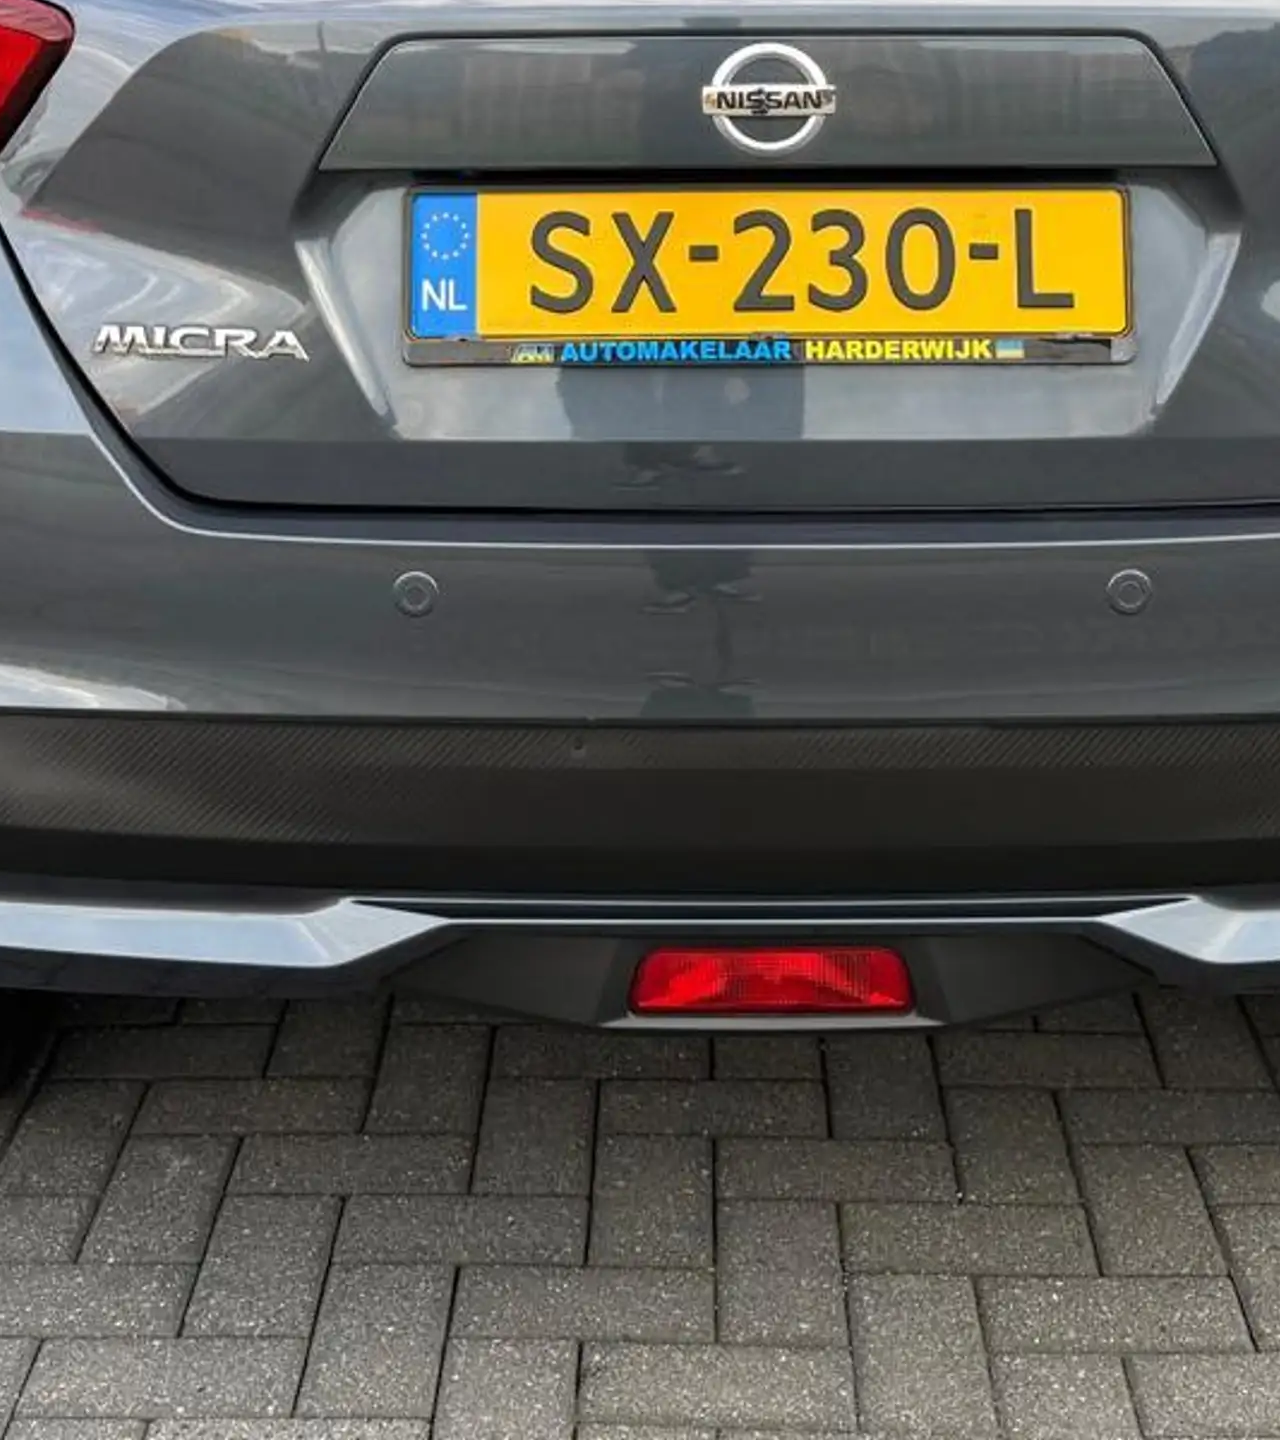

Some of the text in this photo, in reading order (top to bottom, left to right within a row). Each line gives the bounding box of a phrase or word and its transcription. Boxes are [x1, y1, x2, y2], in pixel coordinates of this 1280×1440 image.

[716, 90, 823, 109] NISSAN
[529, 207, 1076, 316] SX-230-L
[421, 279, 467, 311] NL
[92, 323, 311, 364] MICRA
[560, 340, 792, 362] AUTOMAKELAAR
[805, 339, 993, 360] HARDERWIJK
